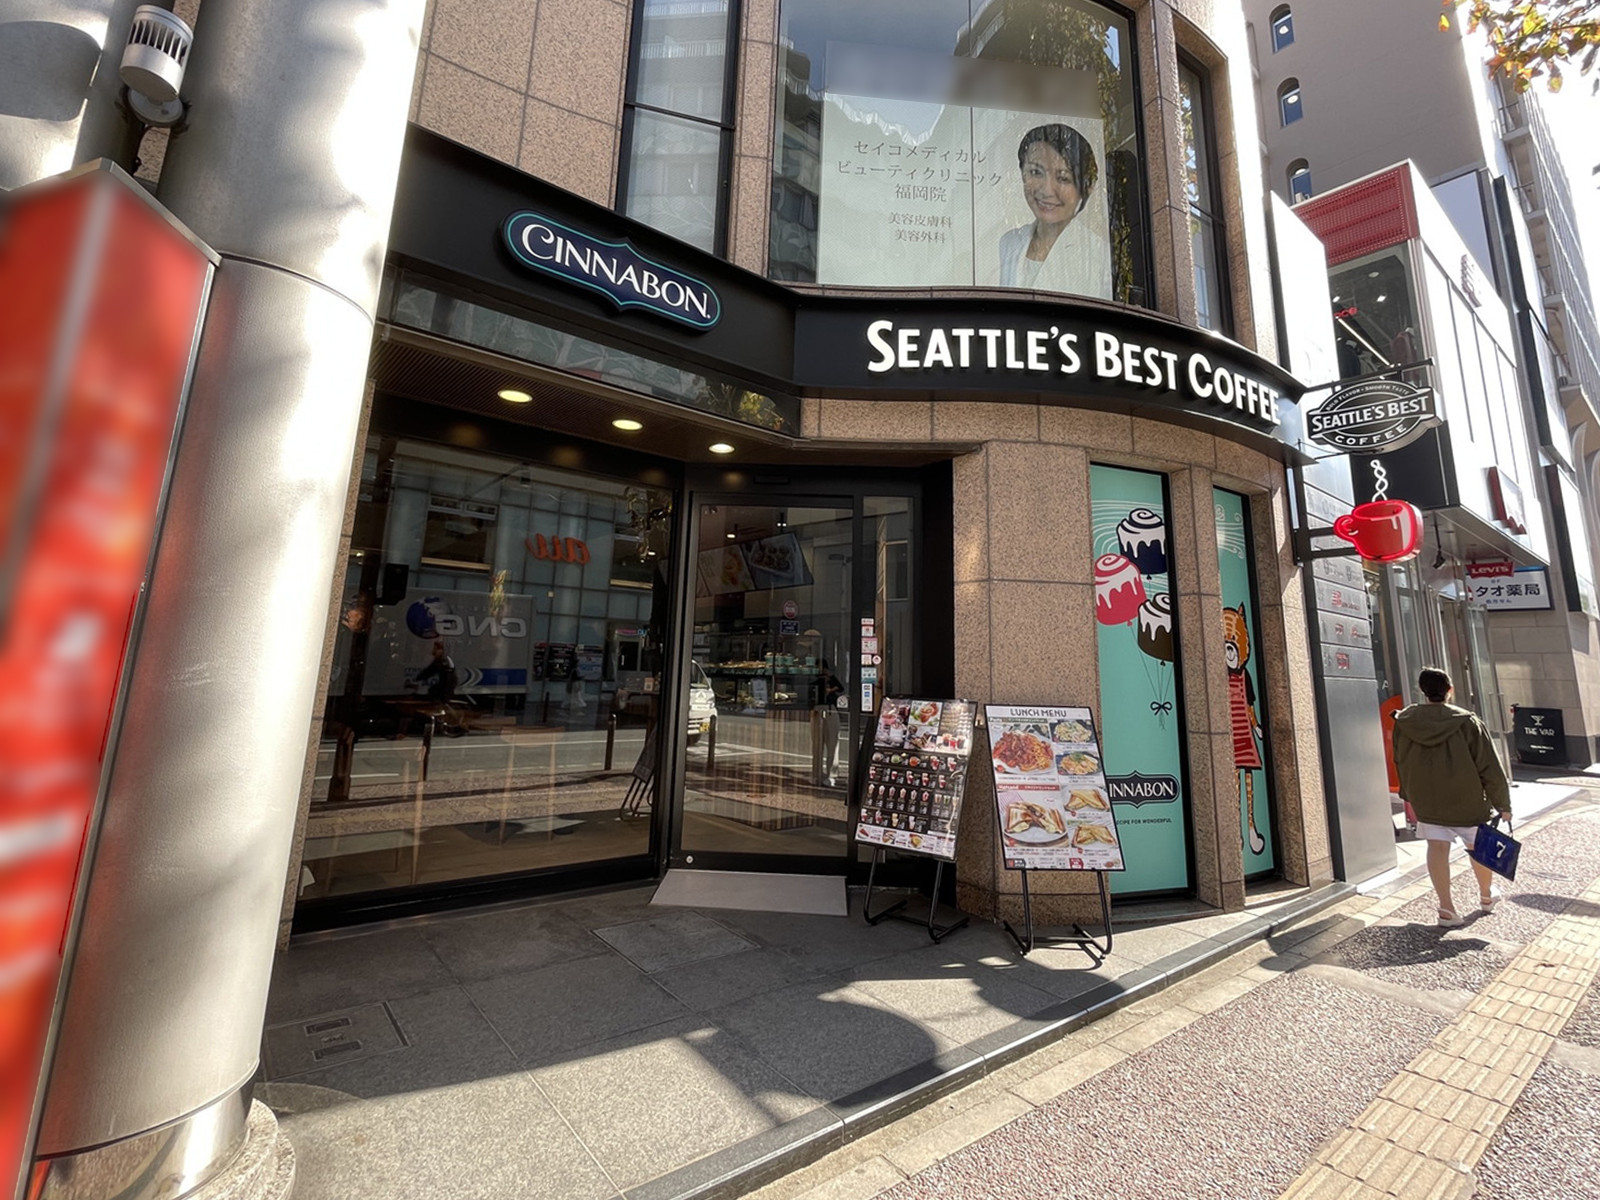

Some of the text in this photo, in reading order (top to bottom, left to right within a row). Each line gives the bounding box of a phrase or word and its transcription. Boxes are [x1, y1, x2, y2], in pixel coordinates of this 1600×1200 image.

[854, 141, 986, 163] セイコメディカル
[838, 160, 1002, 187] ビューティクリニック
[896, 183, 947, 202] 福岡院
[889, 212, 951, 229] 美容皮膚科
[895, 229, 946, 244] 美容外科
[867, 319, 1281, 425] SEATTLE'S BEST COFFEE
[1312, 396, 1429, 432] SEATTLE'S BEST
[1335, 424, 1407, 445] COFFEE
[1476, 584, 1540, 597] タオ薬局
[1010, 708, 1067, 718] LUNCH MENU
[1524, 726, 1538, 736] THE
[1496, 841, 1506, 858] 7
